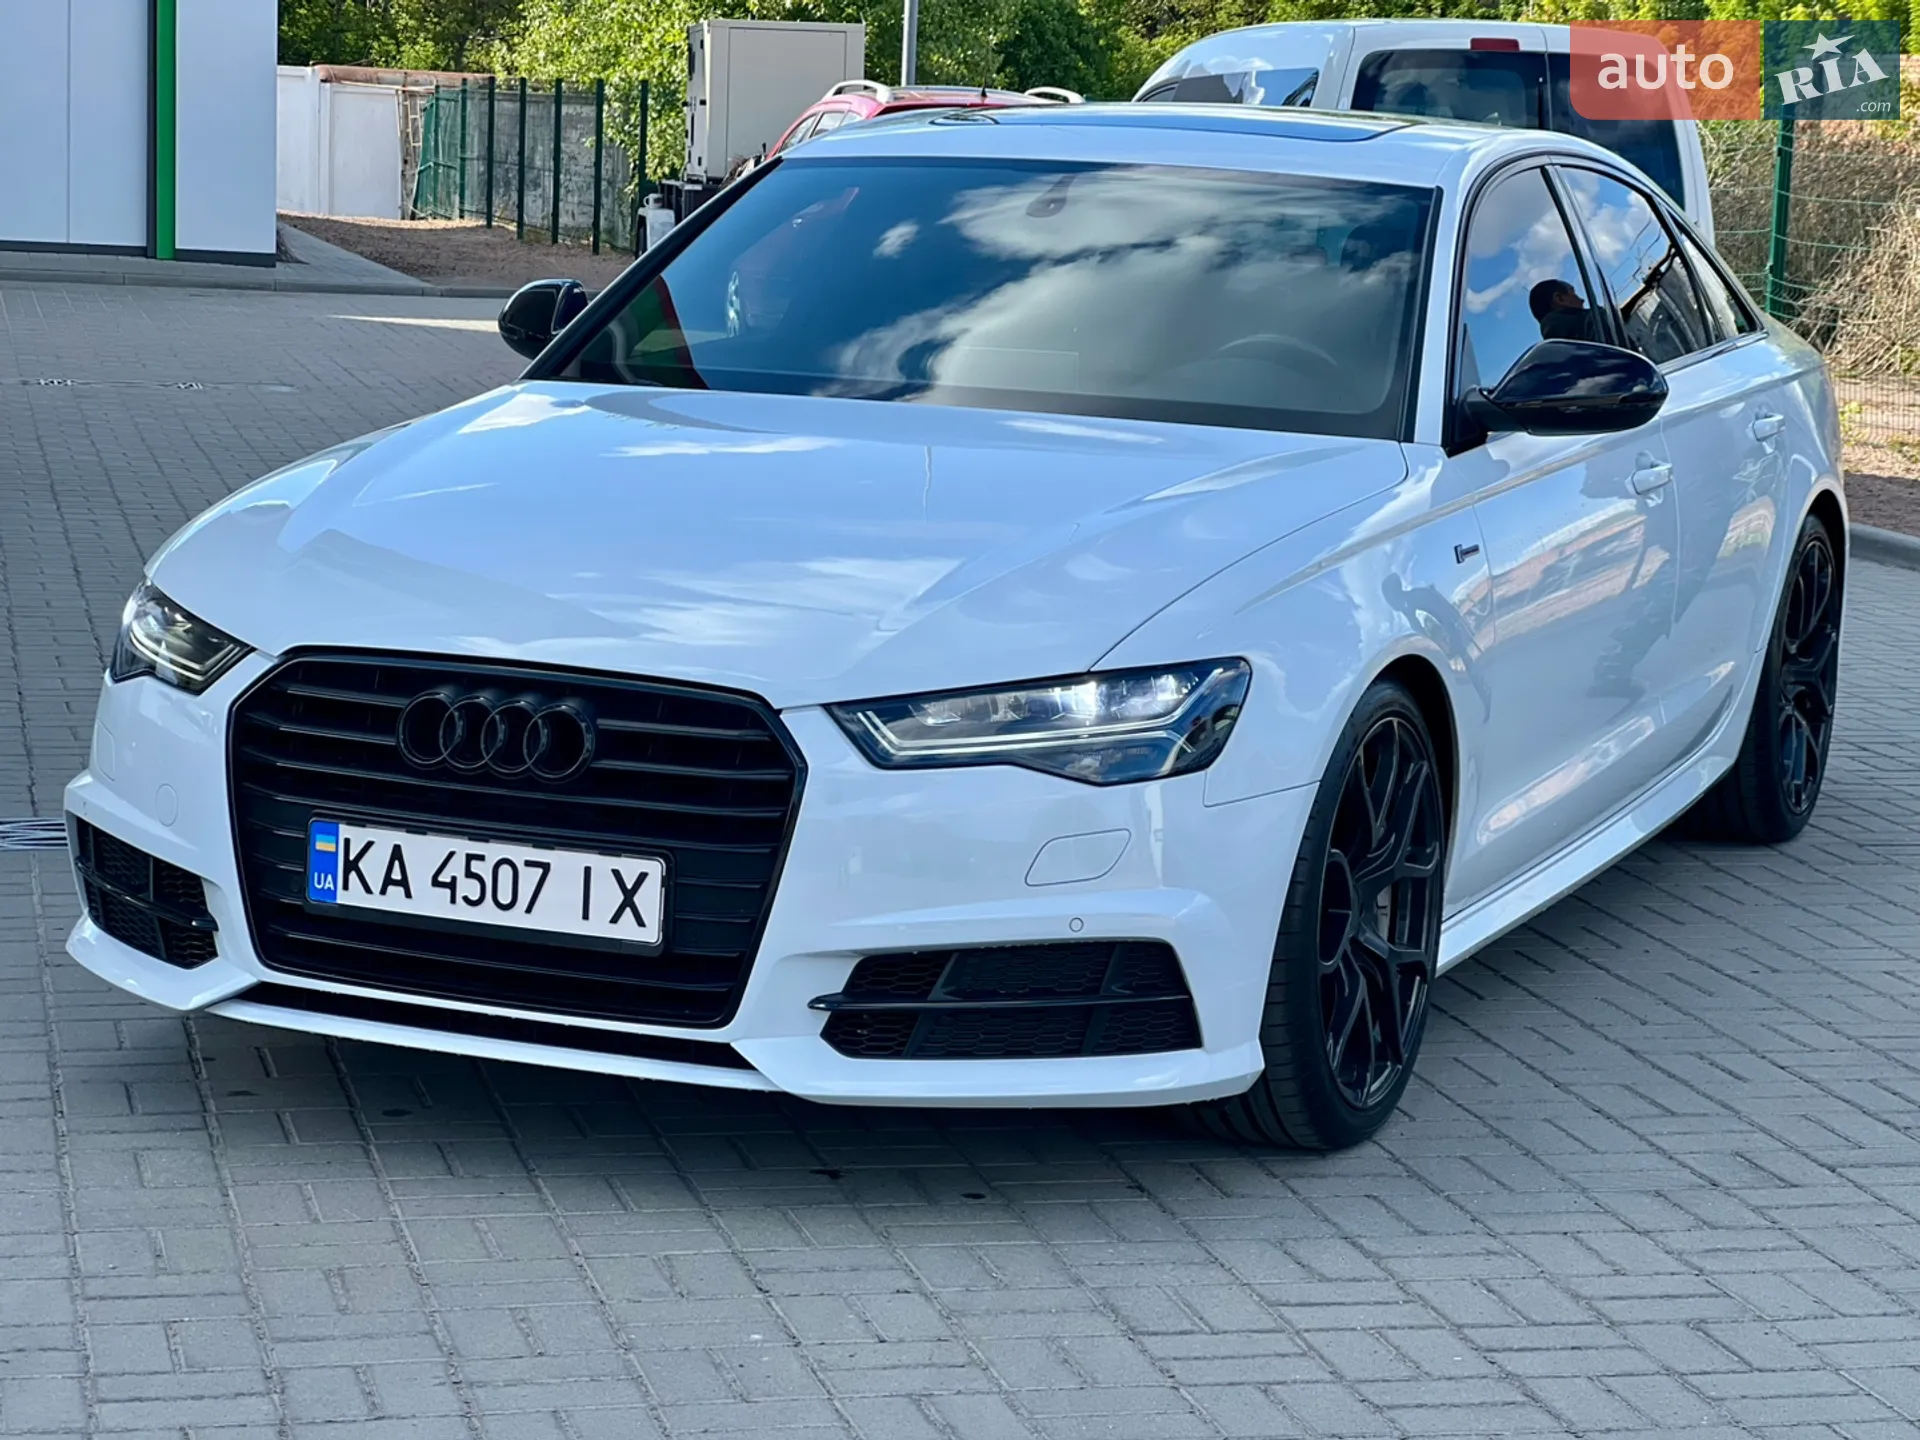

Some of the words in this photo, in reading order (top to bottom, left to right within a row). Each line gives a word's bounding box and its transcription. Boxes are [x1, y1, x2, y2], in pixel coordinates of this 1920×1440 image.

[313, 872, 335, 892] UA
[341, 837, 413, 899] KA
[430, 850, 551, 915] 4507
[581, 865, 649, 928] IX
